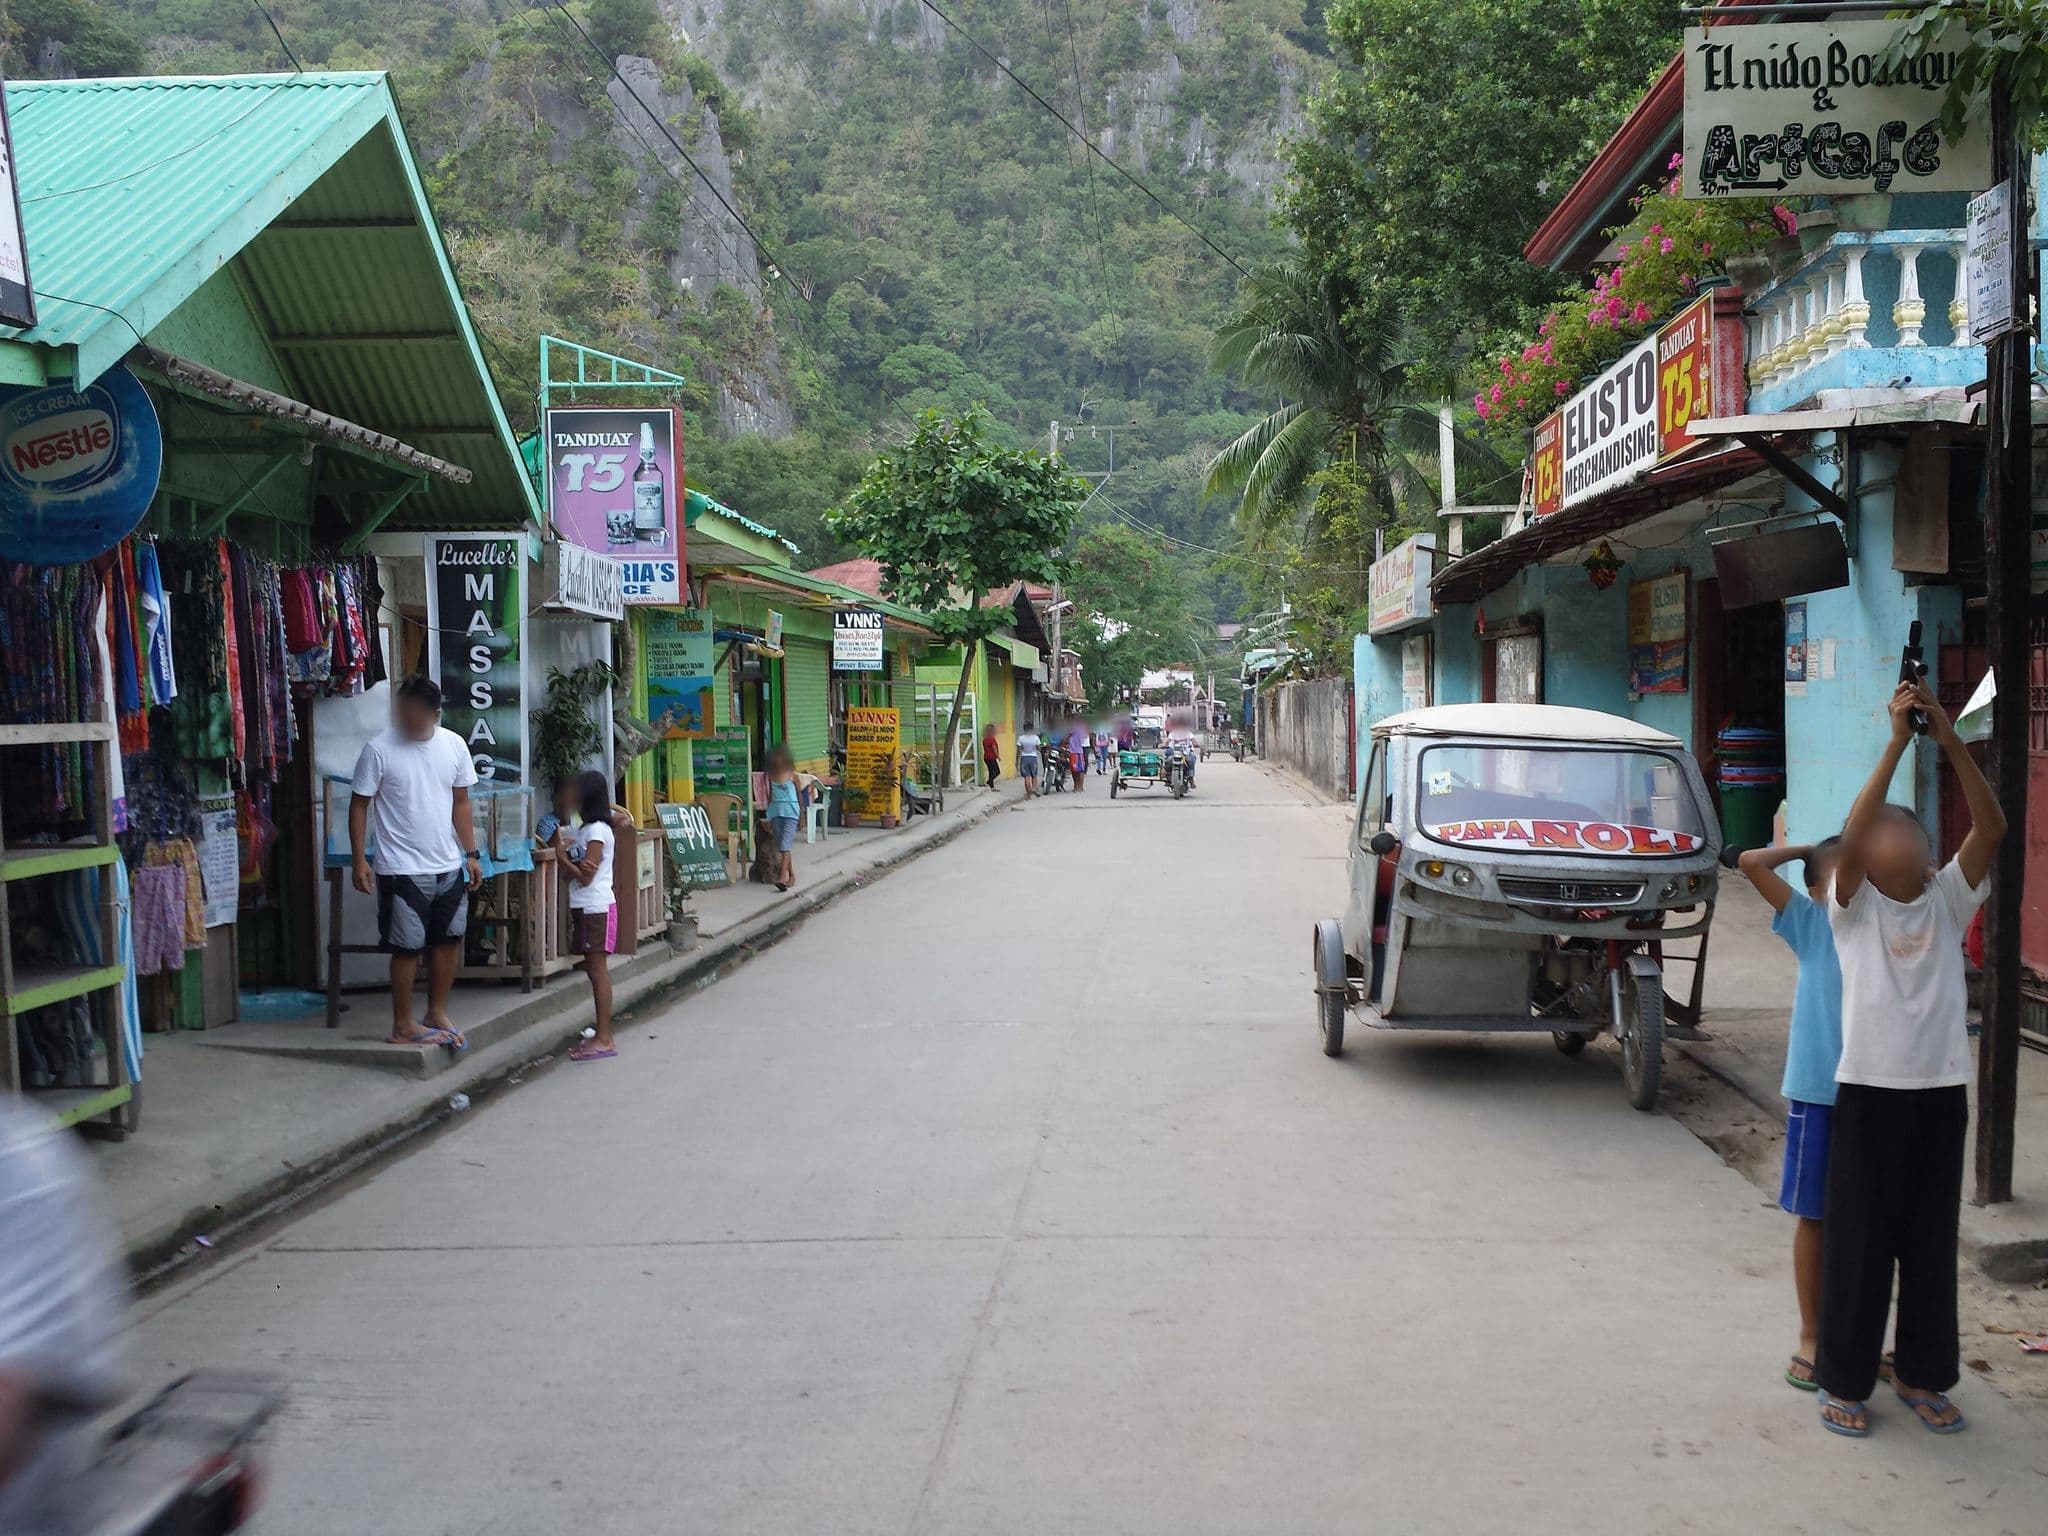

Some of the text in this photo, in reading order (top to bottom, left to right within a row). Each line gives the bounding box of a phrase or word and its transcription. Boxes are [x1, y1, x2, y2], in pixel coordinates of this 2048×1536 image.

[1696, 43, 1739, 91] El
[1742, 42, 1822, 91] nido
[1813, 86, 1838, 112] &
[1659, 318, 1697, 364] TANDUAY
[12, 393, 91, 424] ICE CREAM
[1566, 350, 1655, 462] ELISTO
[1662, 352, 1694, 435] T5
[554, 432, 634, 448] TANDUAY
[1536, 424, 1556, 452] TANDUAY
[559, 452, 628, 493] T5
[1565, 420, 1656, 499] MERCHANDISING
[1537, 449, 1554, 505] T5
[438, 543, 517, 567] Lucelle's
[835, 612, 881, 628] LYNN'S
[851, 711, 897, 725] LYNN'S
[1437, 819, 1534, 842] PAPA
